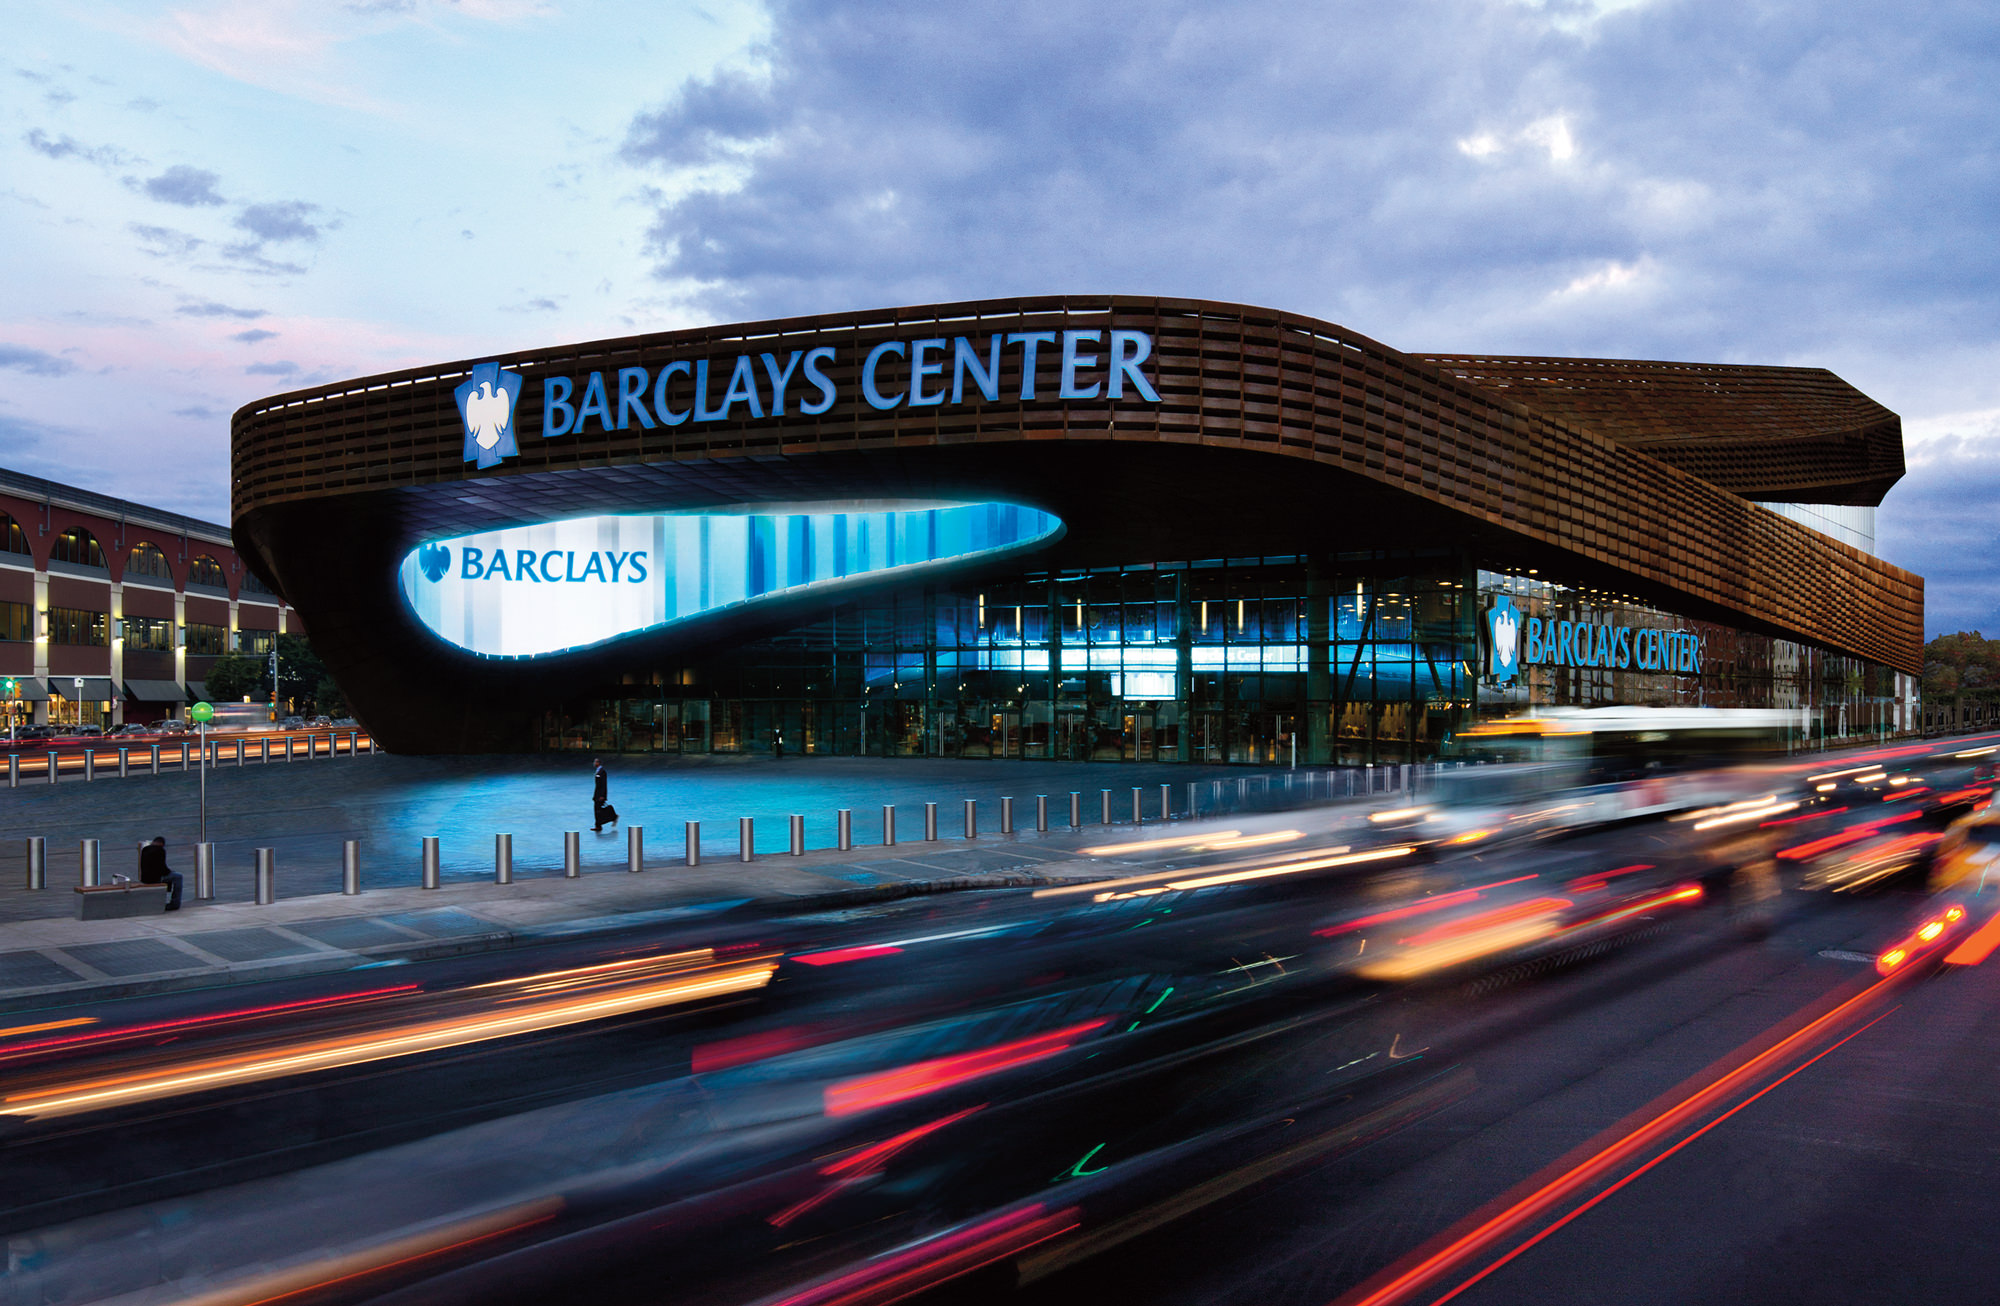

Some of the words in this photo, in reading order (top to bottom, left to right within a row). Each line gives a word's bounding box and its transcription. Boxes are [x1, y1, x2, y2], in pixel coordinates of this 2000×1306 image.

[542, 346, 837, 438] BARCLAYS
[861, 329, 1163, 410] CENTER
[460, 547, 648, 584] BARCLAYS
[1237, 649, 1273, 661] Cener
[1527, 617, 1631, 669] BARCLAYS
[1635, 628, 1701, 674] CENTER
